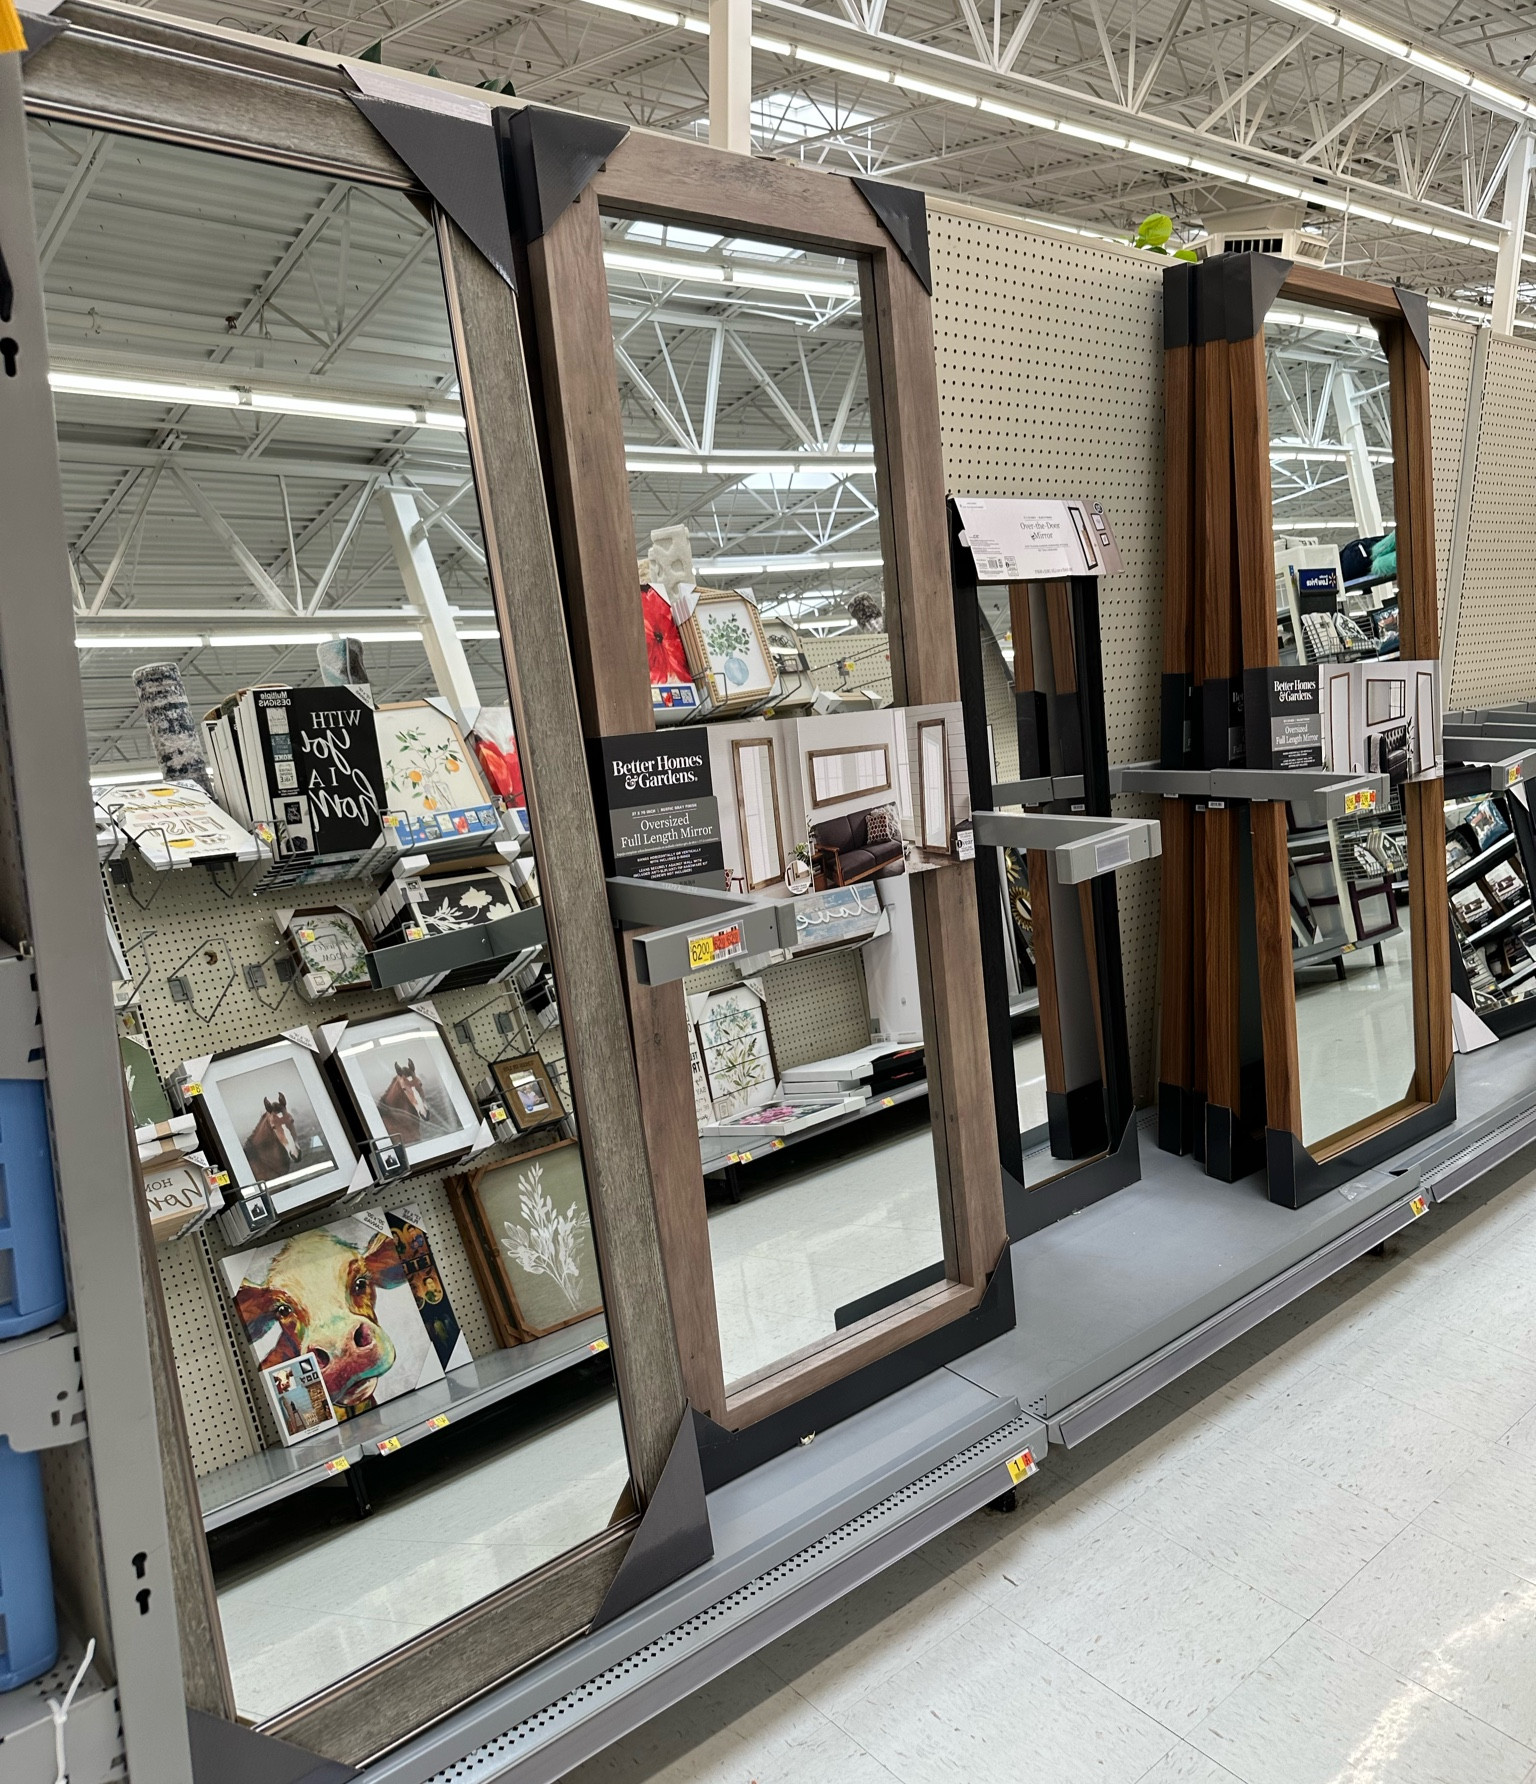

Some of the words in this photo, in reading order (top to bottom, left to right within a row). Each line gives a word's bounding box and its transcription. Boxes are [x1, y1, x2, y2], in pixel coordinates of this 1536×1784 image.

[1033, 531, 1053, 540] Mirror
[1274, 681, 1294, 692] Better
[1295, 680, 1316, 690] Homes
[1284, 723, 1308, 734] Oversized
[1276, 736, 1285, 745] Full
[1285, 734, 1303, 746] Length
[1303, 732, 1318, 743] Mirror
[612, 759, 656, 776] Better
[656, 754, 703, 771] Homes
[640, 813, 690, 831] Oversized
[621, 833, 642, 849] Full
[643, 829, 679, 844] Length
[681, 826, 713, 839] Mirror
